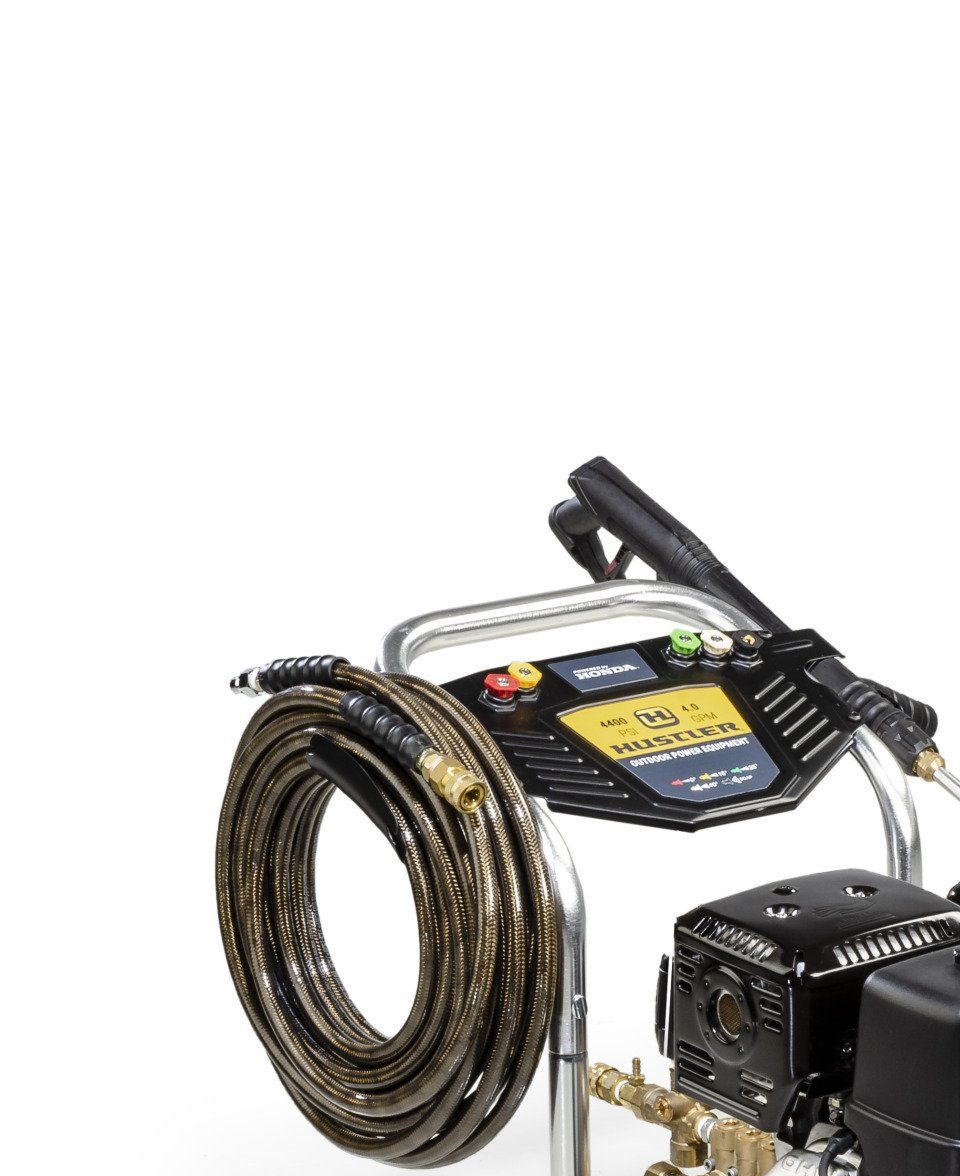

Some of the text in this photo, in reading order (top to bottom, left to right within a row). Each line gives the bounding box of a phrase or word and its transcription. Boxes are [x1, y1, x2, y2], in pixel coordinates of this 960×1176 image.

[575, 664, 637, 680] HONDA
[681, 703, 700, 713] 4.0
[600, 717, 628, 728] 4400
[691, 712, 718, 724] GPM
[609, 722, 741, 754] HUSTLER
[618, 726, 640, 738] PSI
[629, 736, 750, 767] OUTDOOR POWER EQUIPMENT
